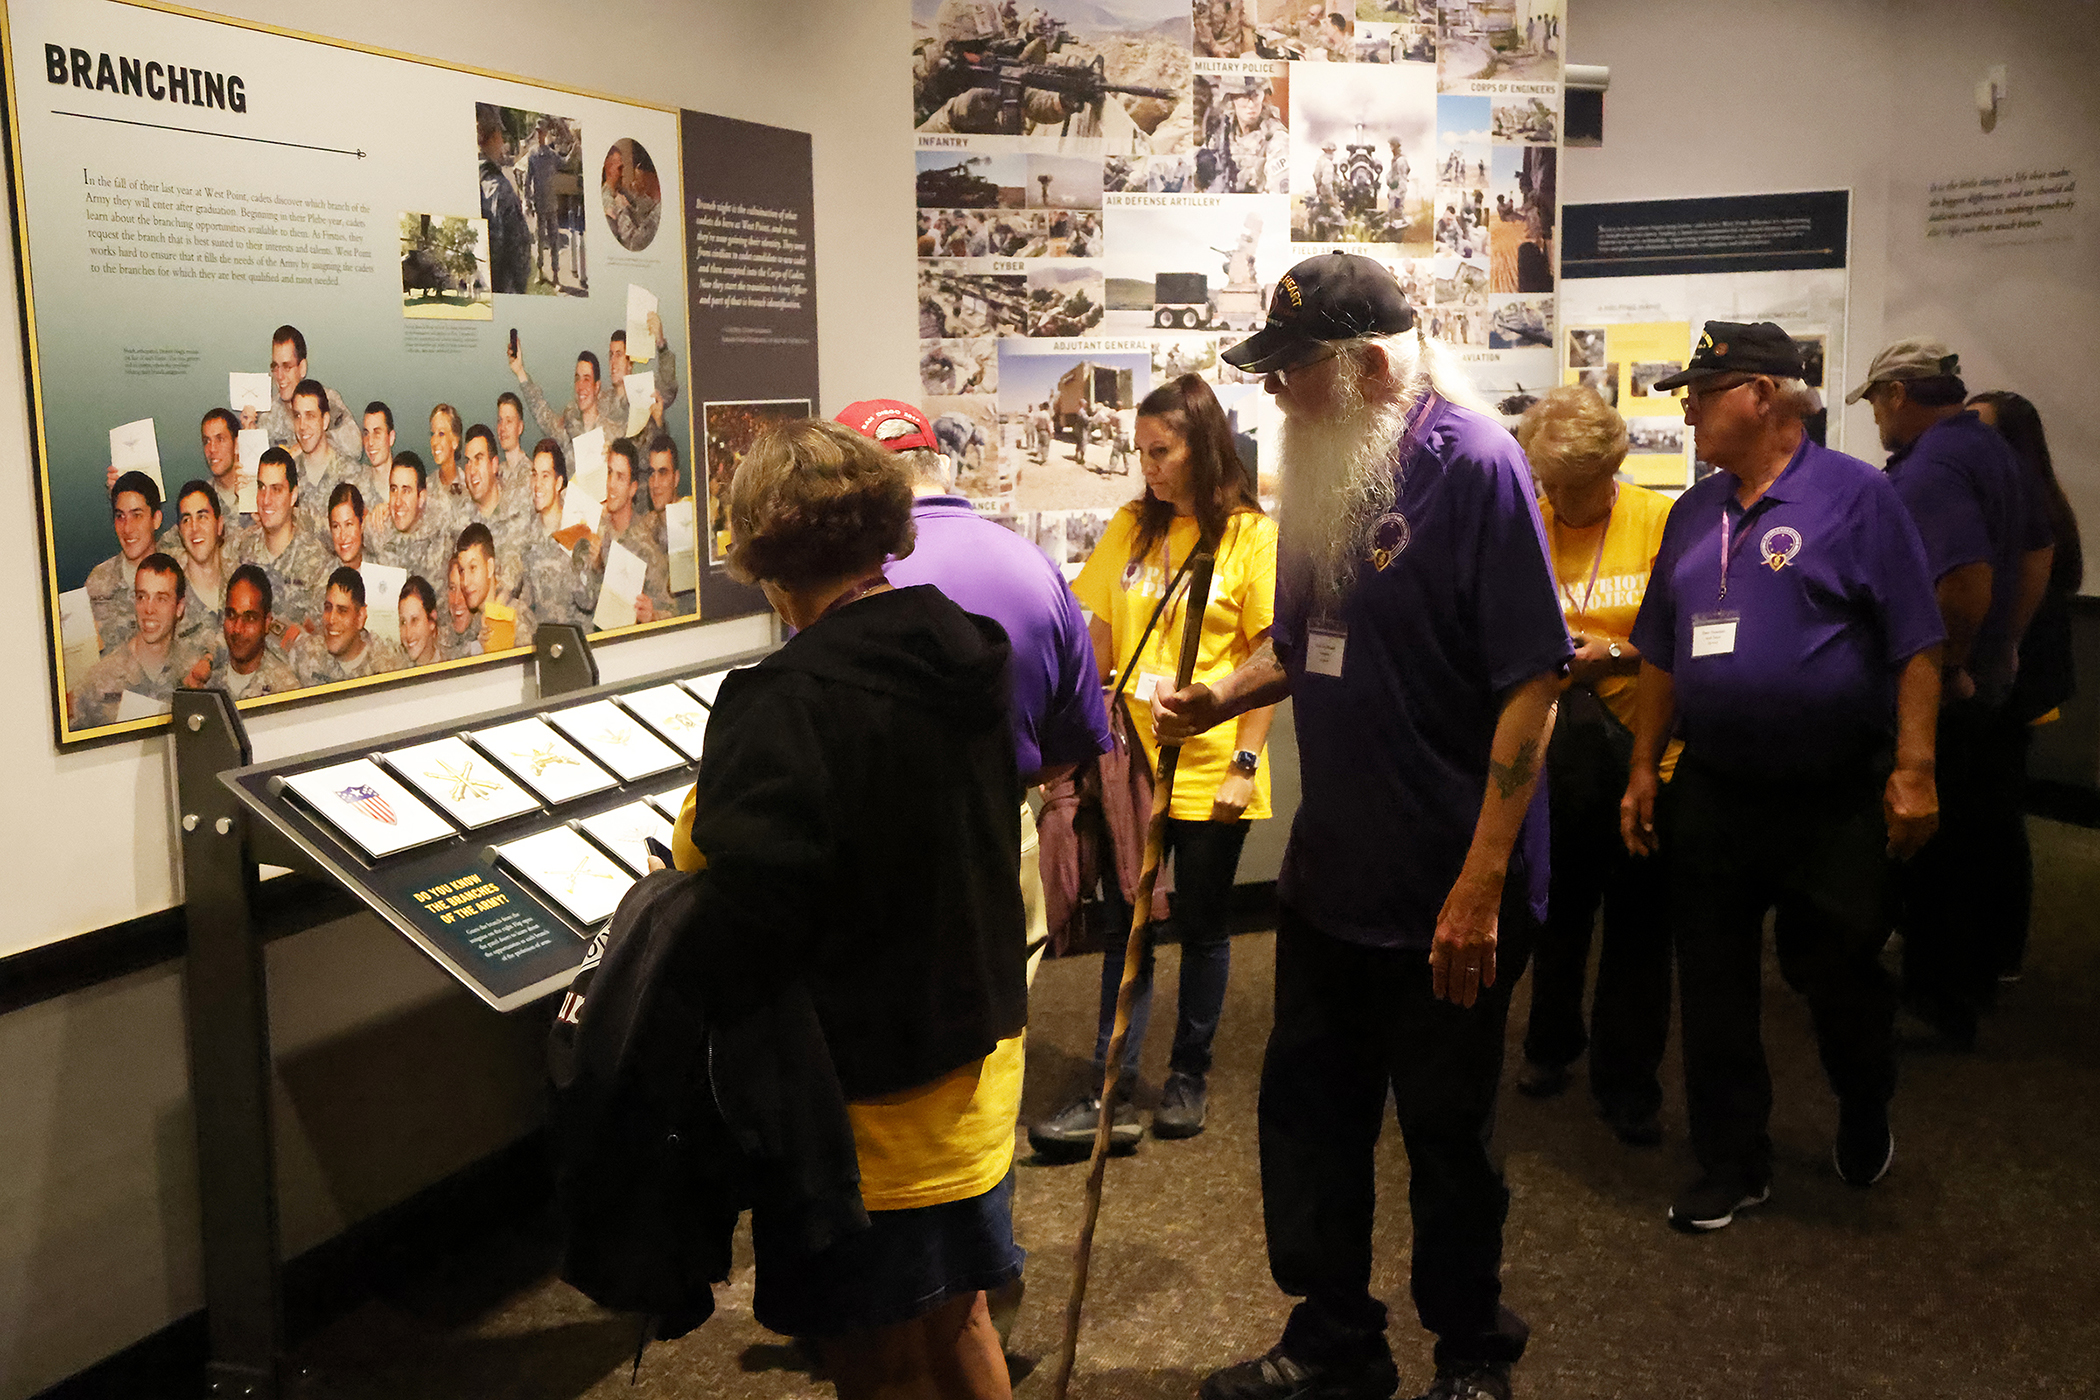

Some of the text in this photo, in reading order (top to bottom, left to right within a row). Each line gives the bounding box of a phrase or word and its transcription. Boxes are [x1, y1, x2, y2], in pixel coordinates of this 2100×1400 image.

[44, 43, 246, 113] BRANCHING
[1195, 62, 1274, 73] MILITARY POLICE
[1470, 82, 1556, 94] CORPS OF ENGINEERS
[918, 136, 968, 147] INFANTRY
[84, 168, 95, 184] In
[98, 176, 112, 187] the
[114, 177, 126, 188] fall
[129, 180, 138, 189] of
[140, 180, 158, 192] their
[162, 182, 174, 193] last
[176, 187, 192, 198] year
[204, 187, 224, 198] West
[250, 193, 272, 204] cadets
[274, 195, 302, 207] discover
[304, 198, 326, 210] which
[328, 200, 350, 212] branch
[352, 203, 360, 212] of
[360, 203, 370, 214] the
[1106, 196, 1221, 206] AIR DEFENSE ARTILLERY
[86, 192, 110, 207] Army
[114, 195, 131, 208] they
[134, 198, 150, 208] will
[152, 200, 173, 210] enter
[176, 201, 193, 212] after
[240, 207, 278, 222] Beginning
[86, 209, 108, 222] learn
[110, 212, 134, 224] about
[138, 214, 150, 226] the
[153, 216, 194, 231] branching
[196, 221, 246, 234] opportunities
[88, 229, 119, 242] request
[122, 230, 134, 240] the
[138, 231, 166, 242] branch
[168, 234, 183, 244] that
[186, 236, 192, 244] is
[194, 236, 209, 246] best
[212, 236, 234, 248] suited
[246, 240, 262, 250] their
[1292, 246, 1318, 254] FIELD
[90, 246, 116, 256] works
[118, 246, 138, 258] hard
[140, 250, 148, 258] to
[151, 252, 176, 260] ensure
[180, 252, 194, 261] that
[220, 254, 232, 264] the
[280, 258, 299, 269] Army
[993, 262, 1024, 270] CYBER
[90, 264, 100, 272] to
[102, 262, 116, 273] the
[119, 264, 156, 276] branches
[158, 266, 169, 276] for
[172, 267, 197, 278] which
[200, 269, 215, 281] they
[231, 270, 246, 280] best
[1282, 274, 1302, 306] HEART
[1054, 340, 1147, 350] ADJUTANT GENERAL
[1462, 354, 1500, 362] AVIATION
[861, 416, 874, 430] SAN
[876, 409, 901, 417] DIEGO
[1560, 590, 1643, 613] PROJEC
[413, 873, 482, 903] DO YOU KNOW
[424, 882, 500, 914] THE BRANCHES
[440, 894, 510, 924] OF THE ARMY?
